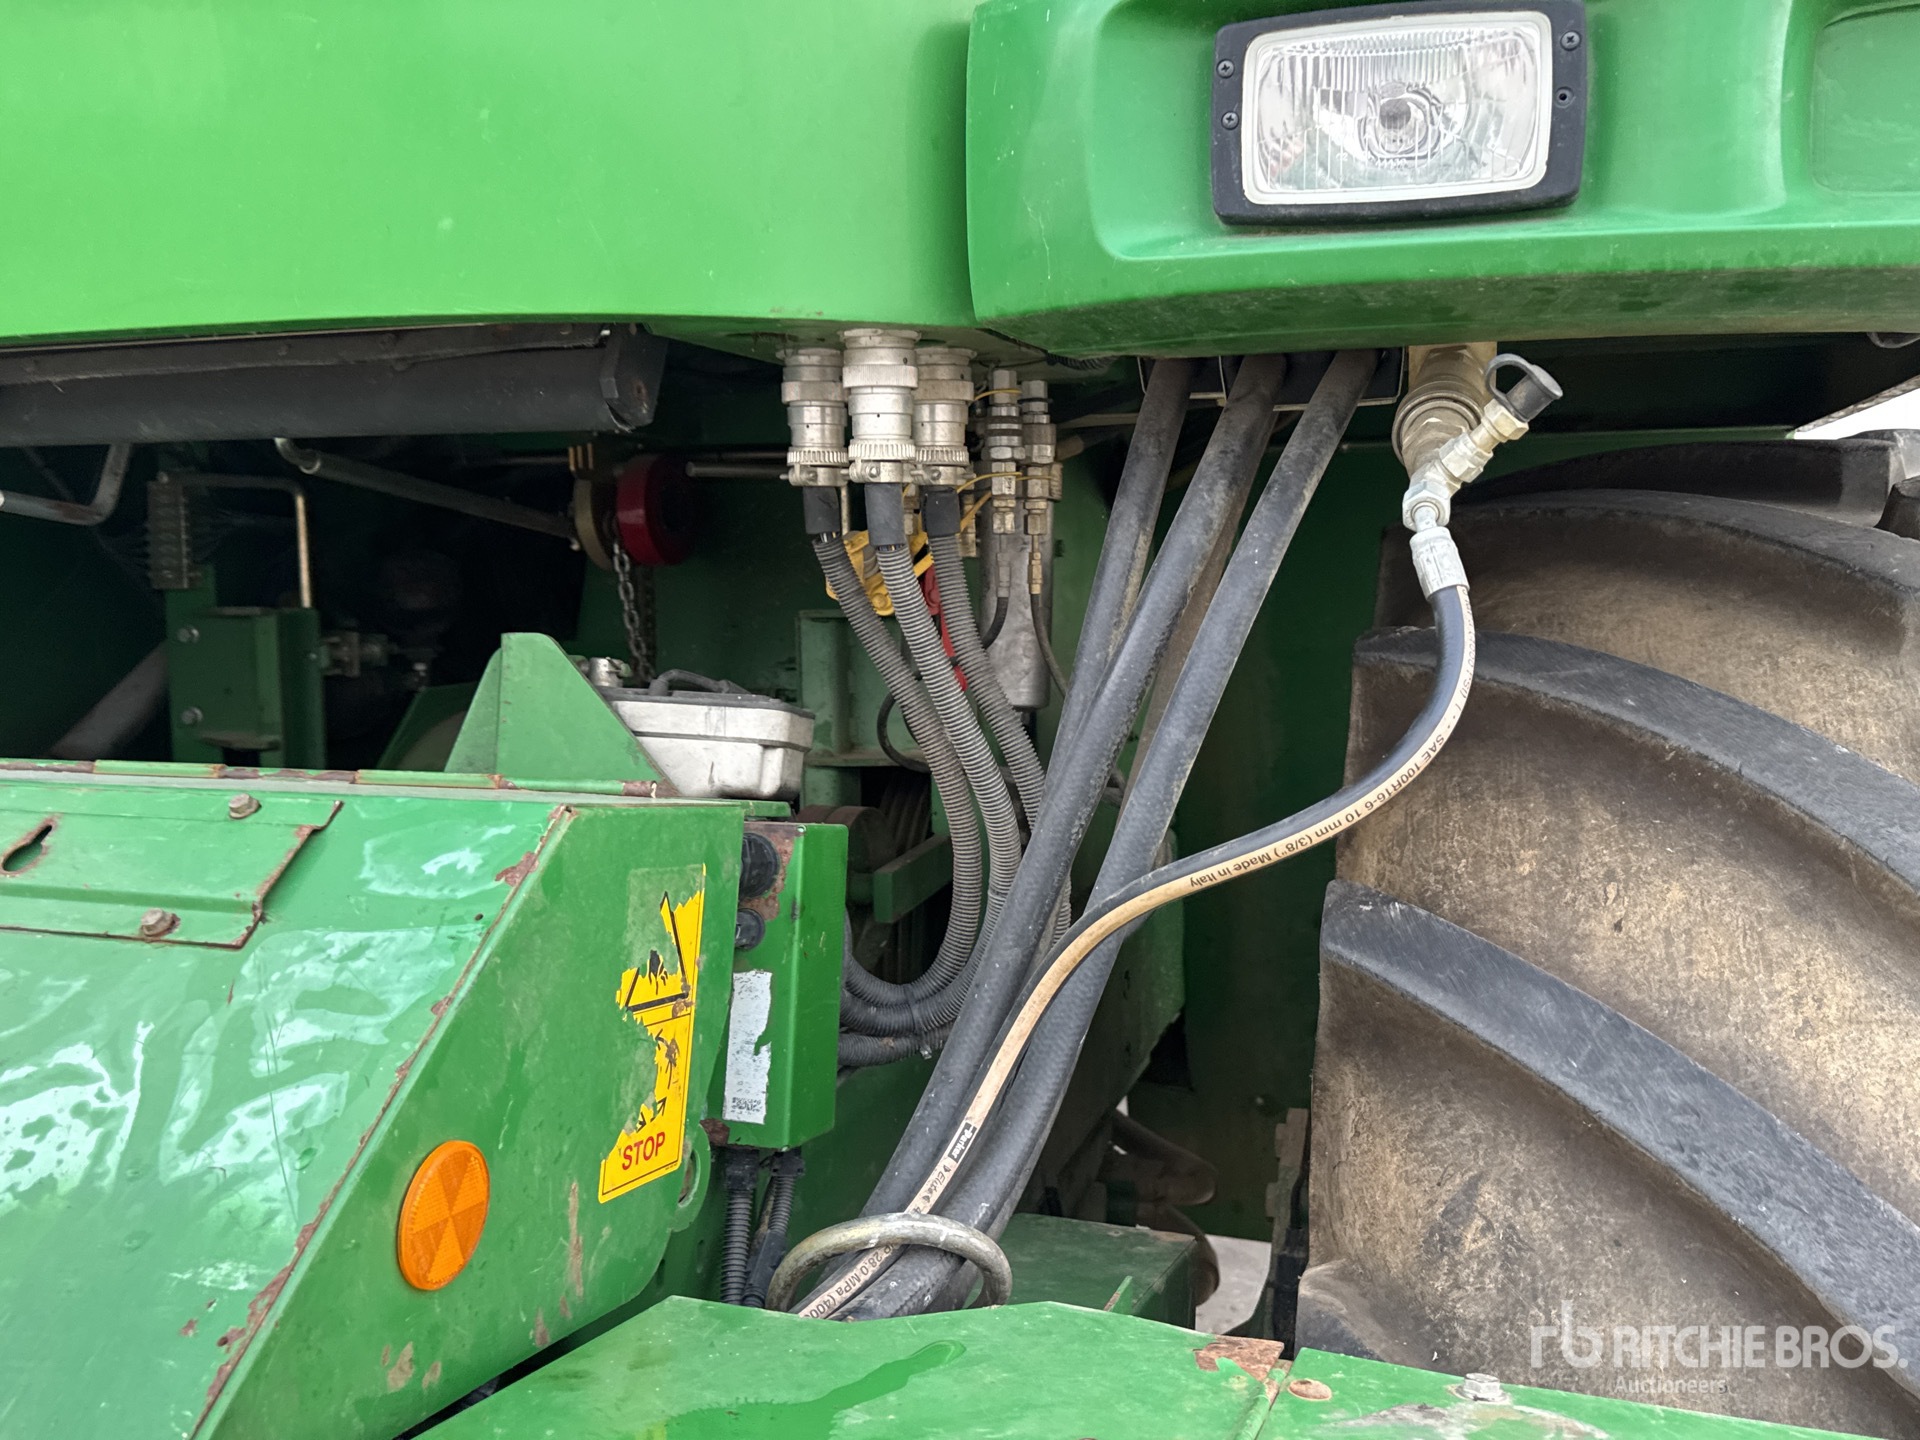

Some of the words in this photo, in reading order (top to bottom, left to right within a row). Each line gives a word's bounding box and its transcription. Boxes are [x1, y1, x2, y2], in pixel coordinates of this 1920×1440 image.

[1421, 734, 1445, 763] SAE
[1364, 763, 1421, 812] 100R16-6
[1344, 808, 1362, 823] 10
[1314, 819, 1343, 838] mm
[1217, 867, 1234, 878] in
[1233, 852, 1272, 872] Made
[1189, 873, 1217, 888] Italy
[622, 1131, 665, 1171] STOP
[951, 1128, 974, 1159] Parker
[859, 1251, 883, 1276] 28.0
[835, 1272, 863, 1296] MPa
